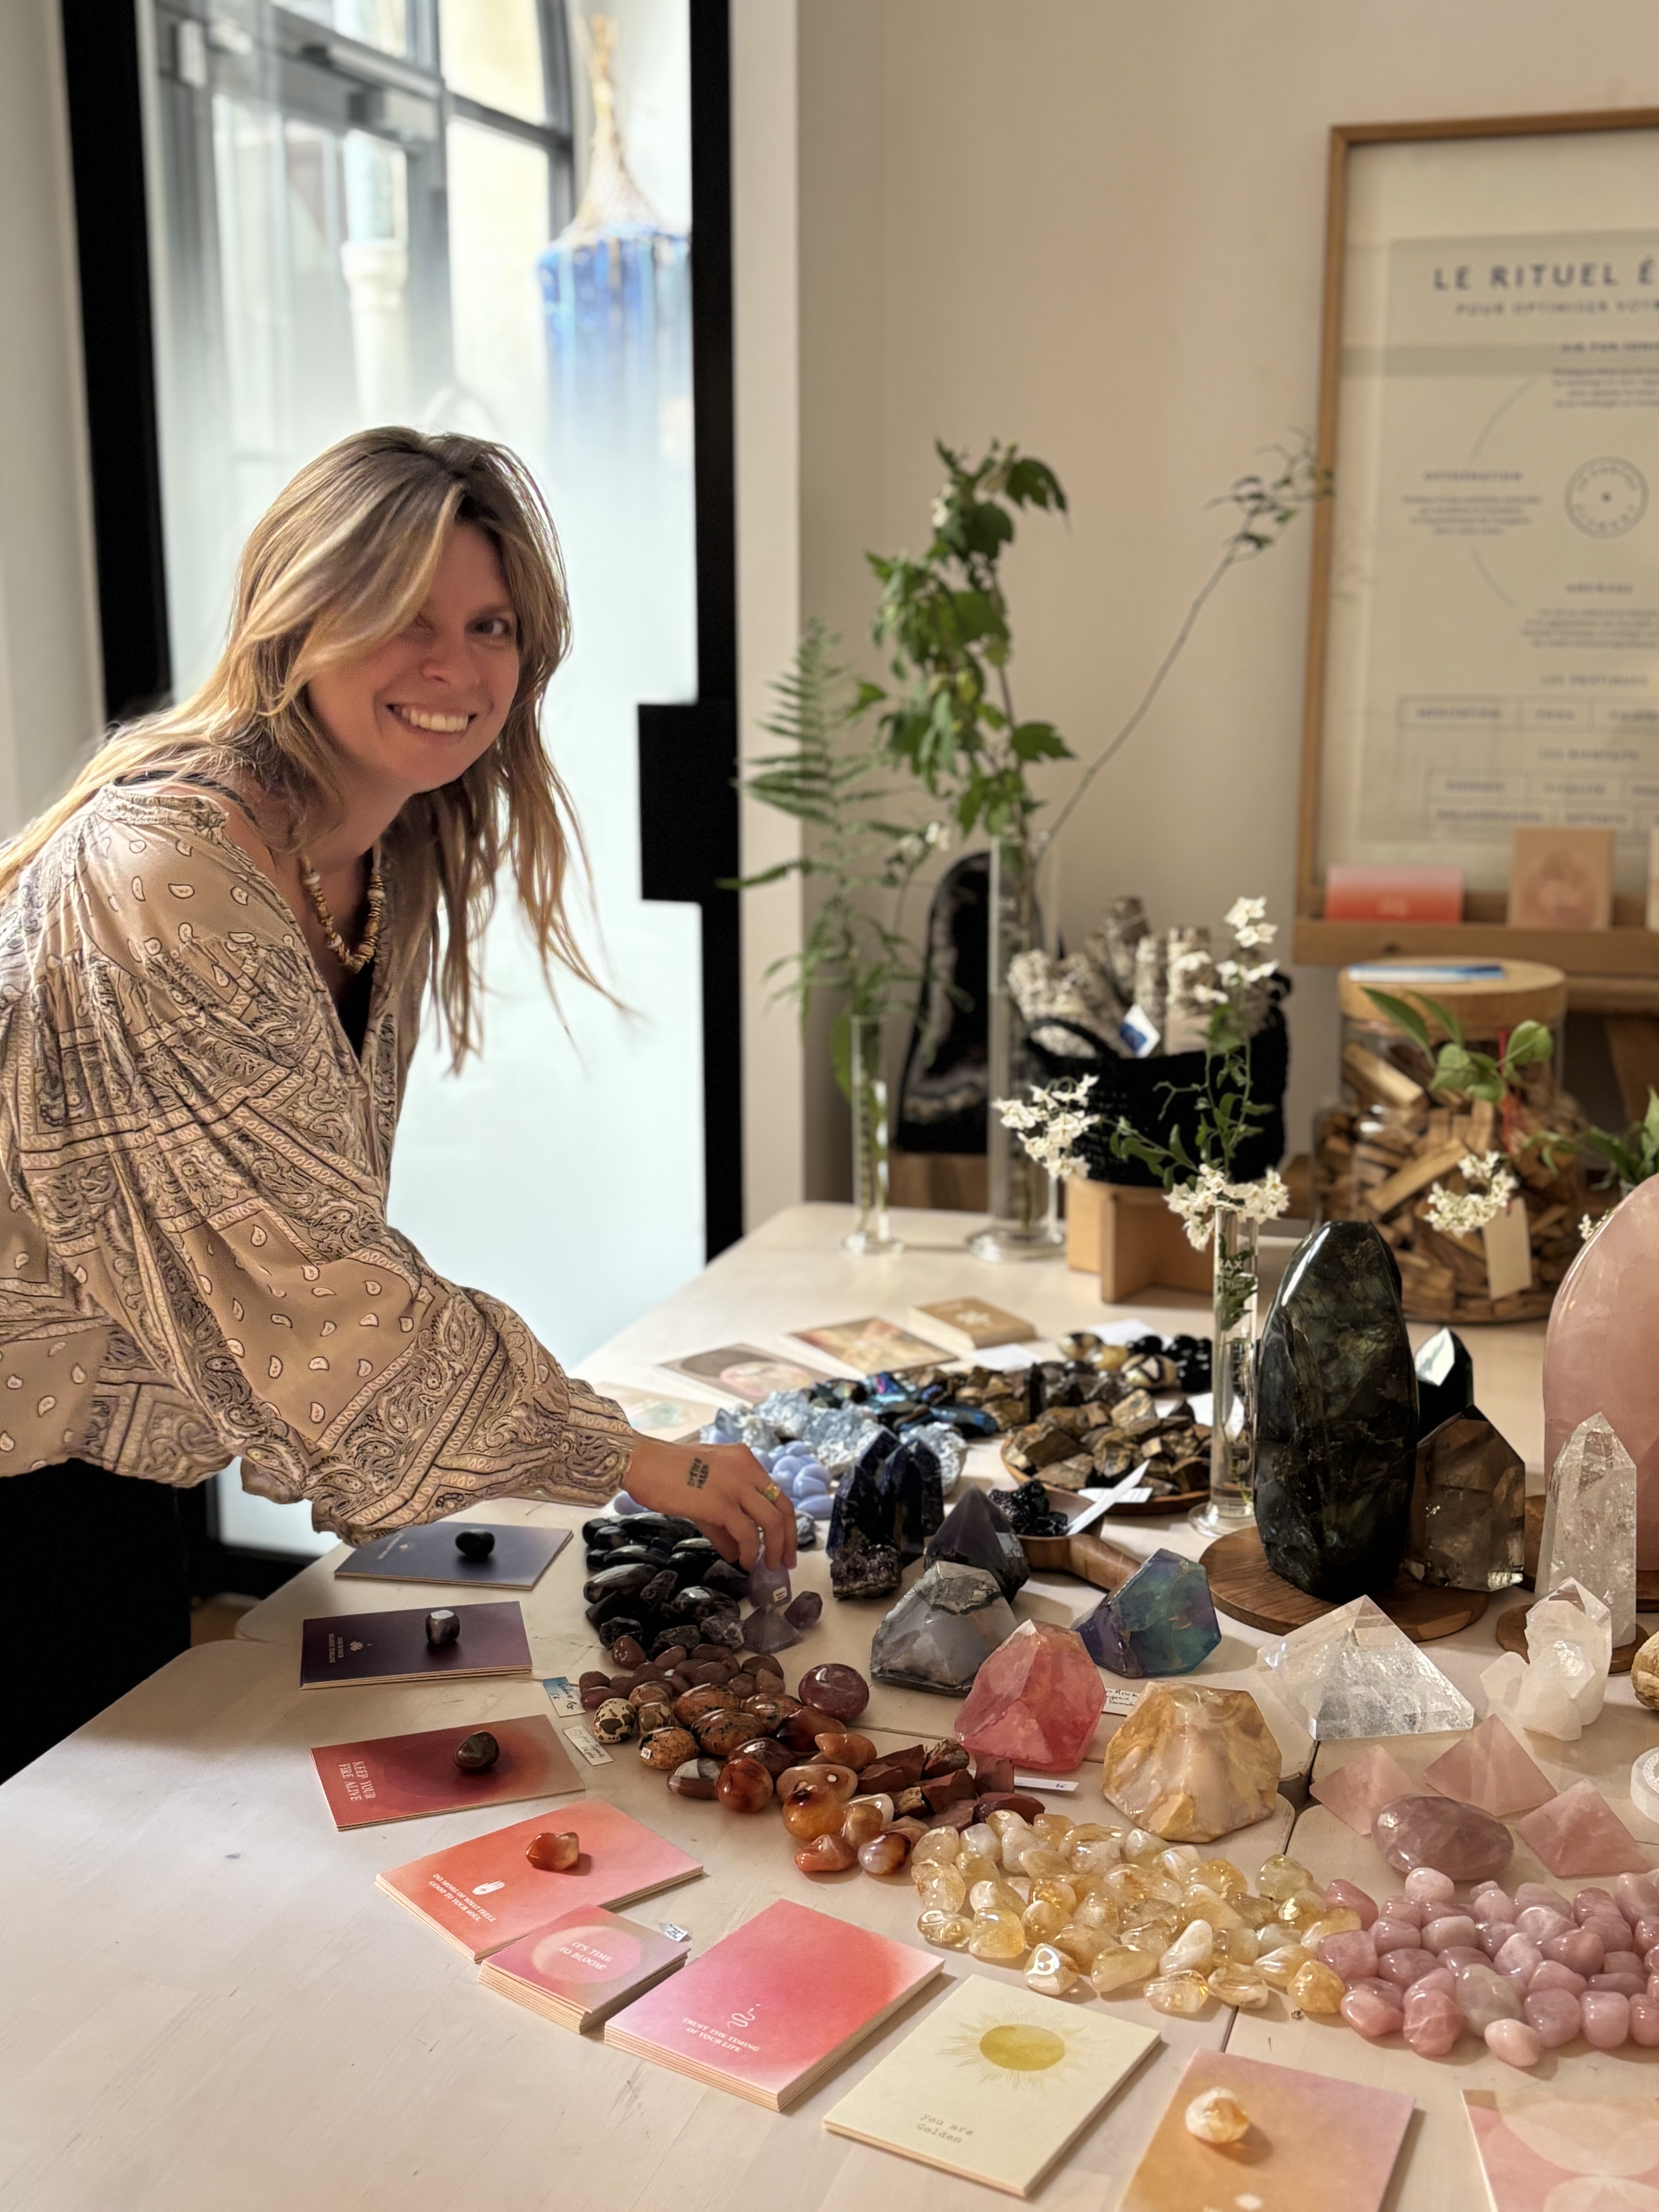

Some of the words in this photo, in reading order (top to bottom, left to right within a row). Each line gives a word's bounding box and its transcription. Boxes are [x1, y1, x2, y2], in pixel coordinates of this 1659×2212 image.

[1434, 265, 1470, 291] LE
[1490, 262, 1617, 288] RITUEL
[338, 1763, 354, 1779] FIRE
[352, 1760, 368, 1779] KEEP
[360, 1780, 376, 1799] YOUR
[344, 1781, 362, 1801] ALIVE
[429, 1881, 447, 1894] GOOD
[452, 1898, 469, 1911] YOUR
[465, 1909, 481, 1922] SOUL
[464, 1896, 481, 1910] WHAT
[477, 1908, 496, 1922] FEELS
[559, 1946, 572, 1955] TO
[570, 1951, 607, 1971] BLOOM!
[589, 1948, 613, 1963] TIME
[682, 2017, 710, 2031] TRUST
[709, 2028, 728, 2039] THE
[728, 2036, 761, 2052] TIMING
[699, 2032, 723, 2045] YOUR
[721, 2042, 743, 2053] LIFE
[917, 2123, 962, 2143] Golden
[920, 2114, 944, 2126] you
[950, 2124, 974, 2136] are
